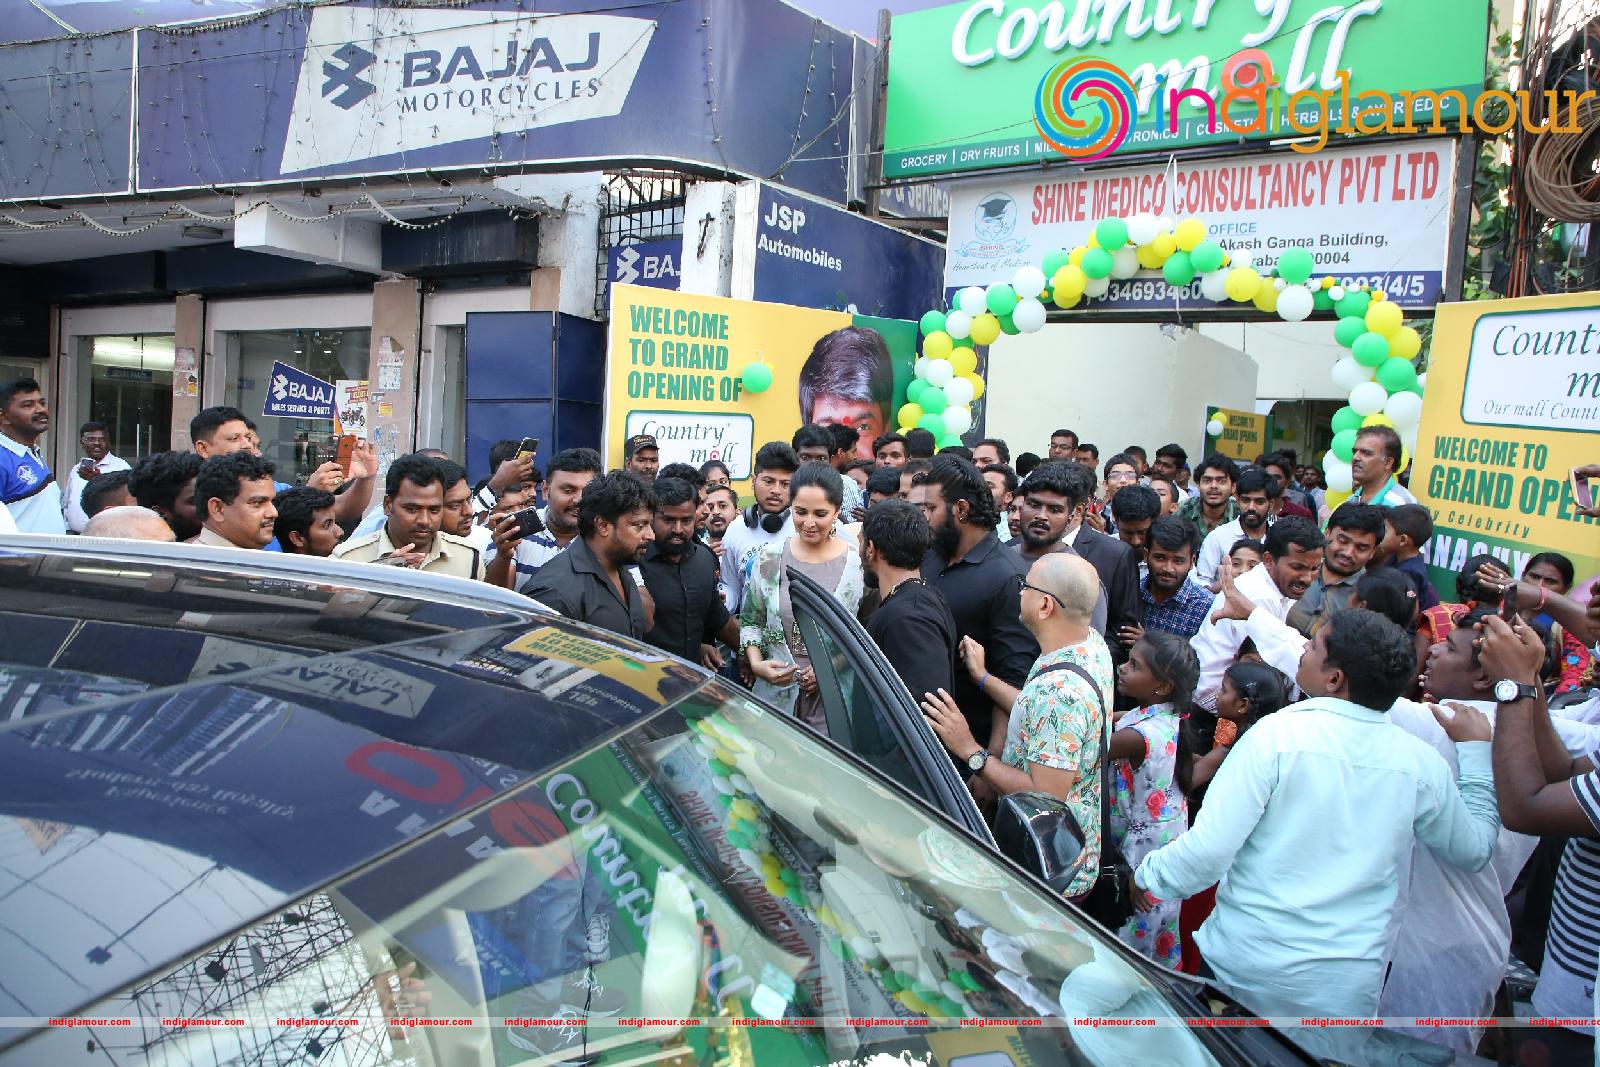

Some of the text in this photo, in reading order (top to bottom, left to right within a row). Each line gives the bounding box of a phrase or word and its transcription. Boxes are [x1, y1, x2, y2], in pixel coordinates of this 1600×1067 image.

[402, 33, 601, 88] BAJAJ
[401, 78, 600, 115] MOTORCYCLES
[900, 153, 947, 169] GROCERY
[960, 149, 981, 162] DRY
[983, 147, 1020, 160] FRUITS
[1032, 151, 1439, 225] SHINE MEDICO CONSULTANCY PVT LTD
[764, 202, 806, 234] JSP
[1209, 222, 1257, 234] OFFICE
[758, 233, 842, 271] Automobiles
[1219, 237, 1263, 250] Akash
[1320, 232, 1389, 249] Building,
[1098, 281, 1202, 301] 34693460
[630, 304, 729, 340] WELCOME
[629, 338, 729, 371] TO GRAND
[289, 381, 333, 404] BAJAJ
[627, 370, 742, 402] OPENING OF
[1484, 400, 1508, 415] Our
[1514, 400, 1549, 417] mall
[642, 421, 724, 447] Country
[1434, 436, 1548, 471] WELCOME TO
[1427, 464, 1513, 510] GRAND
[1448, 510, 1530, 538] Celebrity
